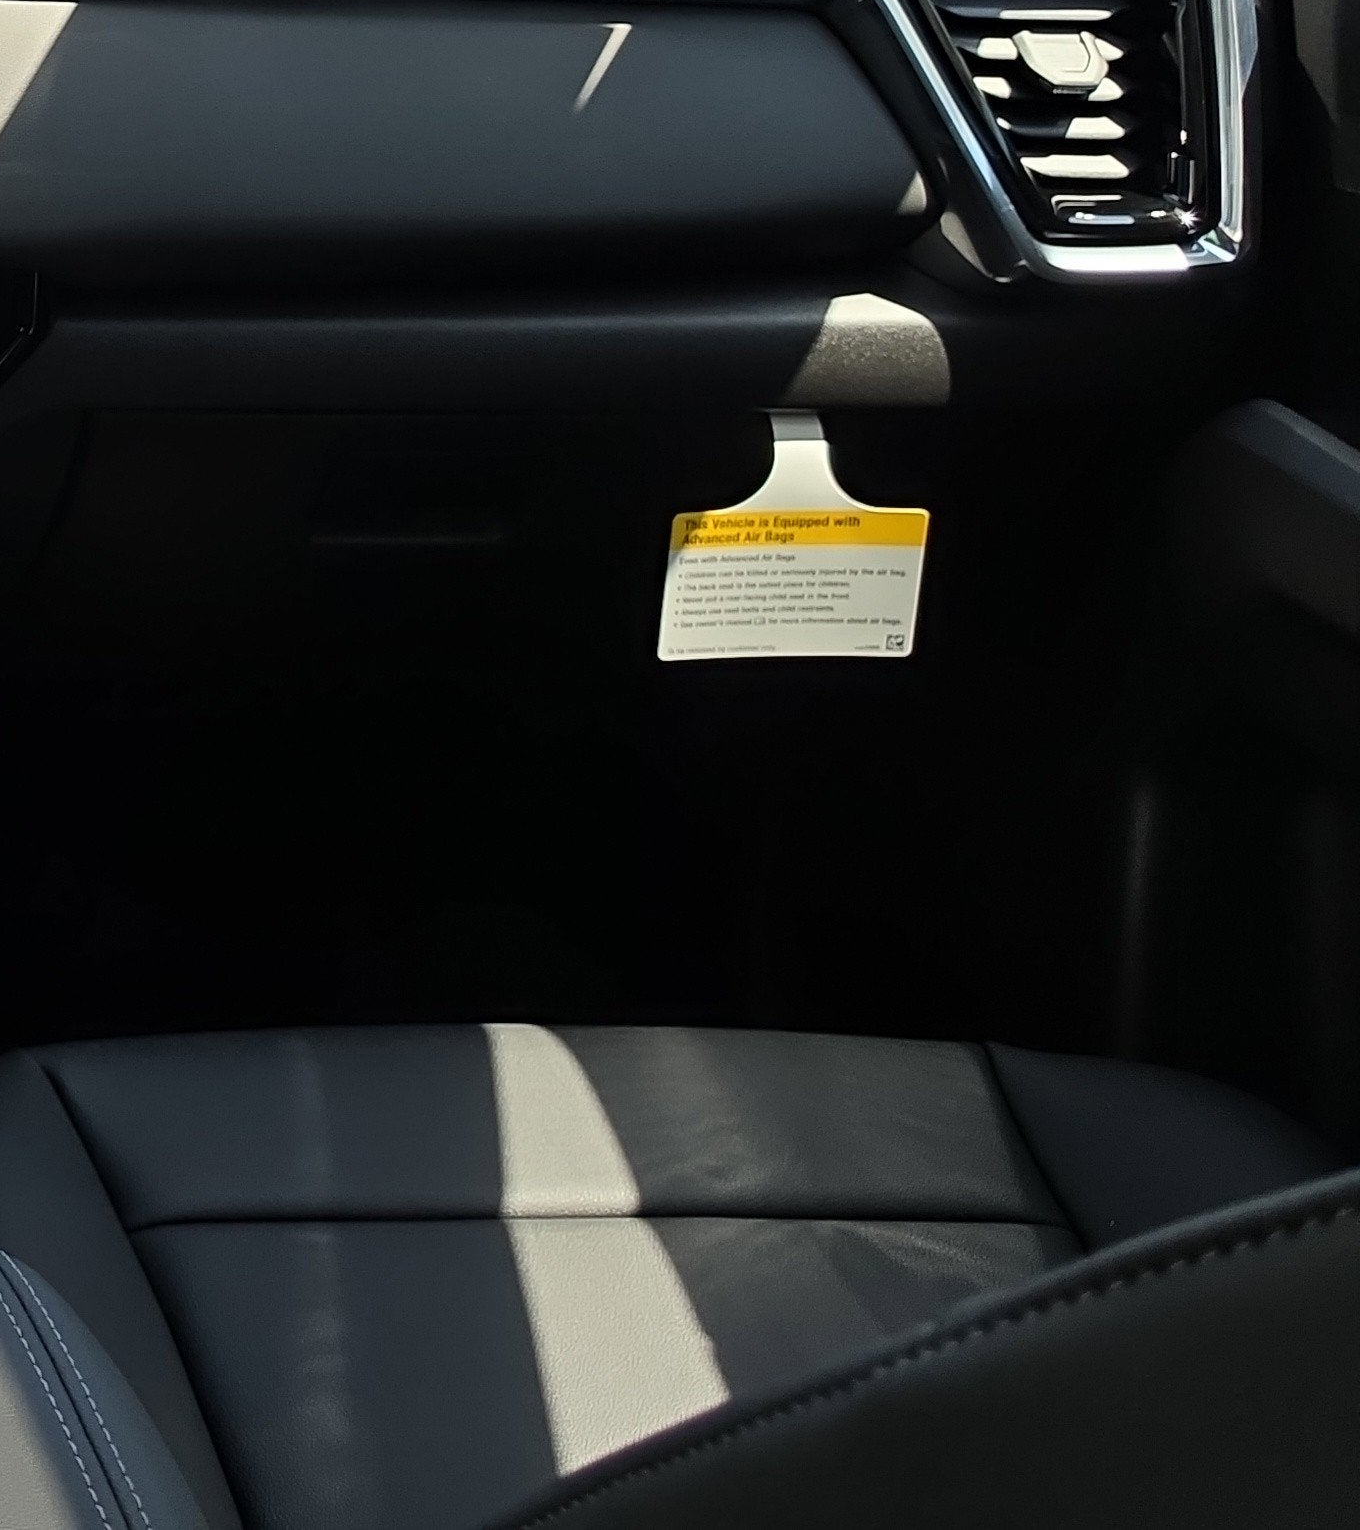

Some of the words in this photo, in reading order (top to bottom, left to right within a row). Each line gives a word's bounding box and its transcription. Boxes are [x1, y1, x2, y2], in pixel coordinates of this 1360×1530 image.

[683, 517, 709, 530] This
[712, 516, 755, 529] Vehicle
[757, 516, 770, 528] is
[772, 514, 830, 529] Equipped
[832, 515, 861, 527] with
[681, 530, 741, 544] Advanced
[743, 530, 760, 542] Air
[763, 530, 796, 543] Bags
